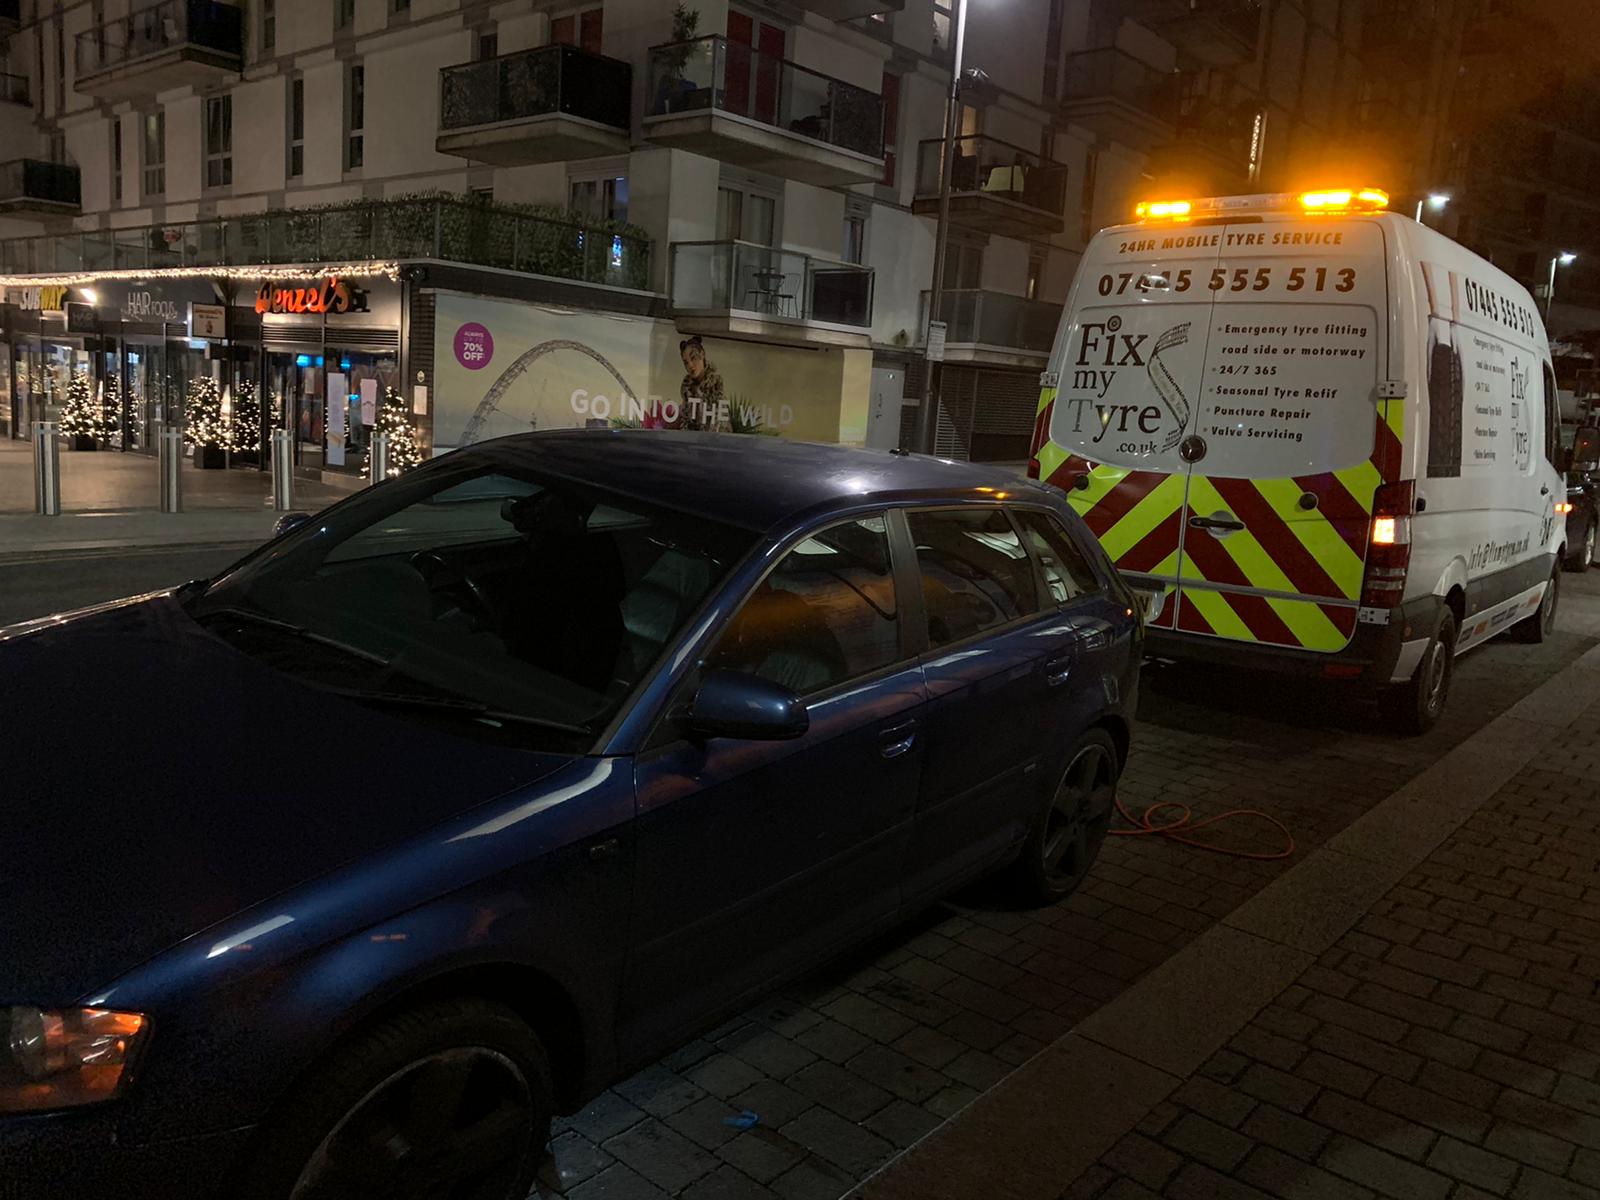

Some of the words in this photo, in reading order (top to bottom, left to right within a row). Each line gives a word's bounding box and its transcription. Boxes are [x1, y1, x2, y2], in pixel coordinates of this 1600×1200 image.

[1120, 240, 1155, 254] 24HR
[1161, 235, 1220, 249] MOBILE
[1226, 232, 1266, 246] TYRE
[1271, 231, 1343, 246] SERVICE
[1207, 268, 1271, 294] 555
[1286, 267, 1357, 292] 513
[19, 286, 67, 311] SUBWAY
[255, 277, 350, 314] Wenzel's
[1464, 277, 1499, 322] 07445
[1500, 296, 1518, 330] 555
[1075, 315, 1148, 366] Fix
[1224, 325, 1288, 336] Emergency
[1293, 325, 1319, 337] tyre
[1325, 325, 1368, 338] fitting
[463, 342, 484, 352] 70%
[463, 351, 484, 361] OFF
[1222, 345, 1249, 355] road
[1253, 345, 1278, 355] side
[1283, 346, 1297, 355] or
[1301, 347, 1366, 359] motorway
[1219, 364, 1251, 376] 24/7
[1254, 365, 1278, 376] 365
[1072, 369, 1117, 398] my
[1216, 385, 1269, 397] Seasonal
[1273, 387, 1300, 399] Tyre
[570, 388, 611, 420] GO
[619, 392, 680, 423] INTO
[687, 396, 731, 426] THE
[738, 402, 795, 429] WILD
[1214, 406, 1265, 418] Puncture
[1270, 408, 1312, 420] Repair
[1068, 398, 1161, 444] Tyre
[1211, 426, 1244, 437] Valve
[1247, 427, 1303, 442] Servicing
[1116, 441, 1158, 454] .couk
